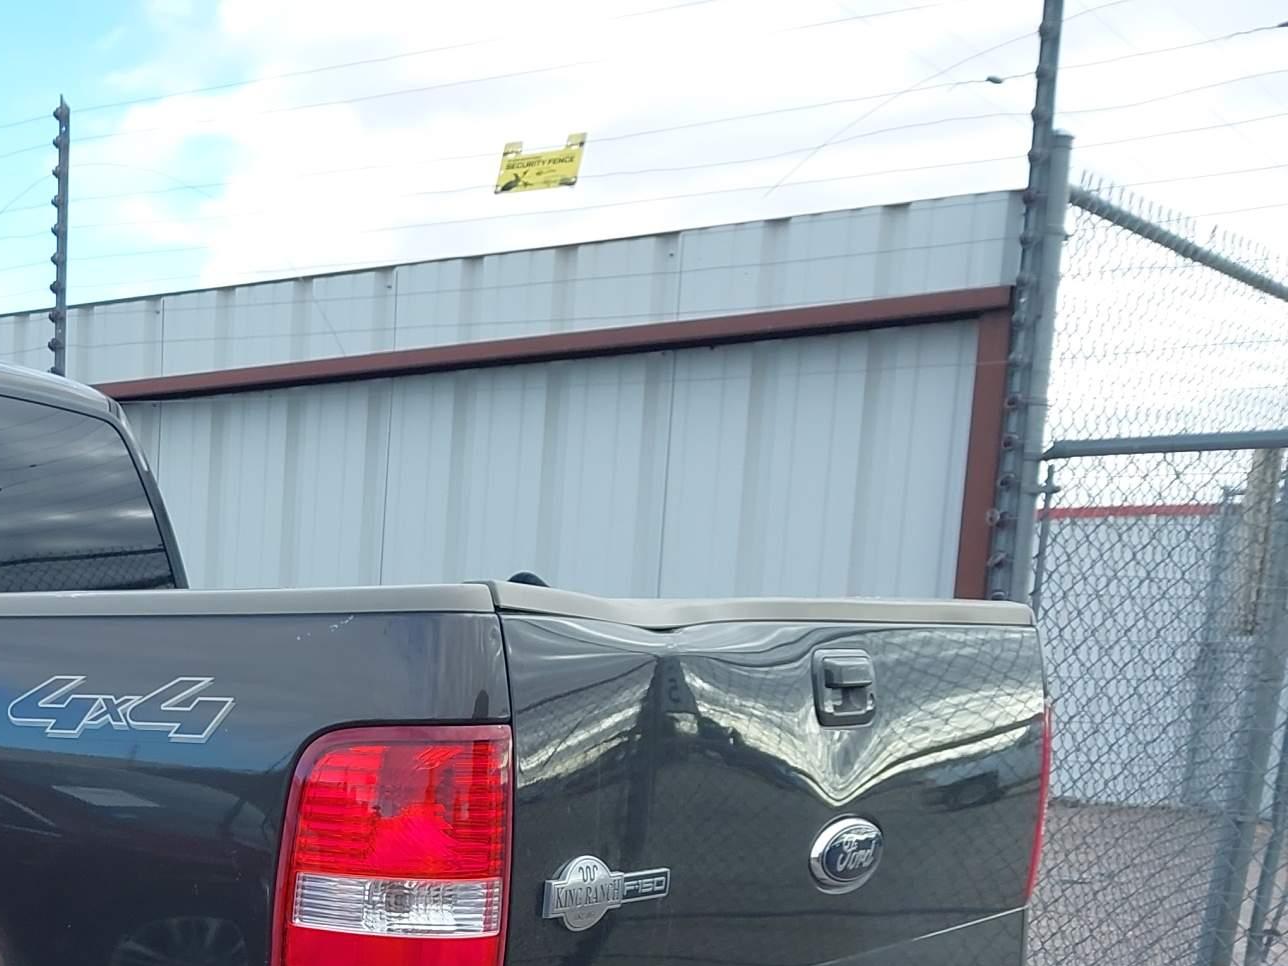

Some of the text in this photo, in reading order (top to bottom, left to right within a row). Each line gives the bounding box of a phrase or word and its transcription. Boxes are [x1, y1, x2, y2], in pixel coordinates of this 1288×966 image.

[505, 159, 547, 170] SECURITY
[547, 155, 575, 165] FENCE
[8, 675, 236, 744] 4x4
[837, 836, 876, 872] Ford
[554, 886, 583, 910] KING
[585, 879, 622, 905] RANCH
